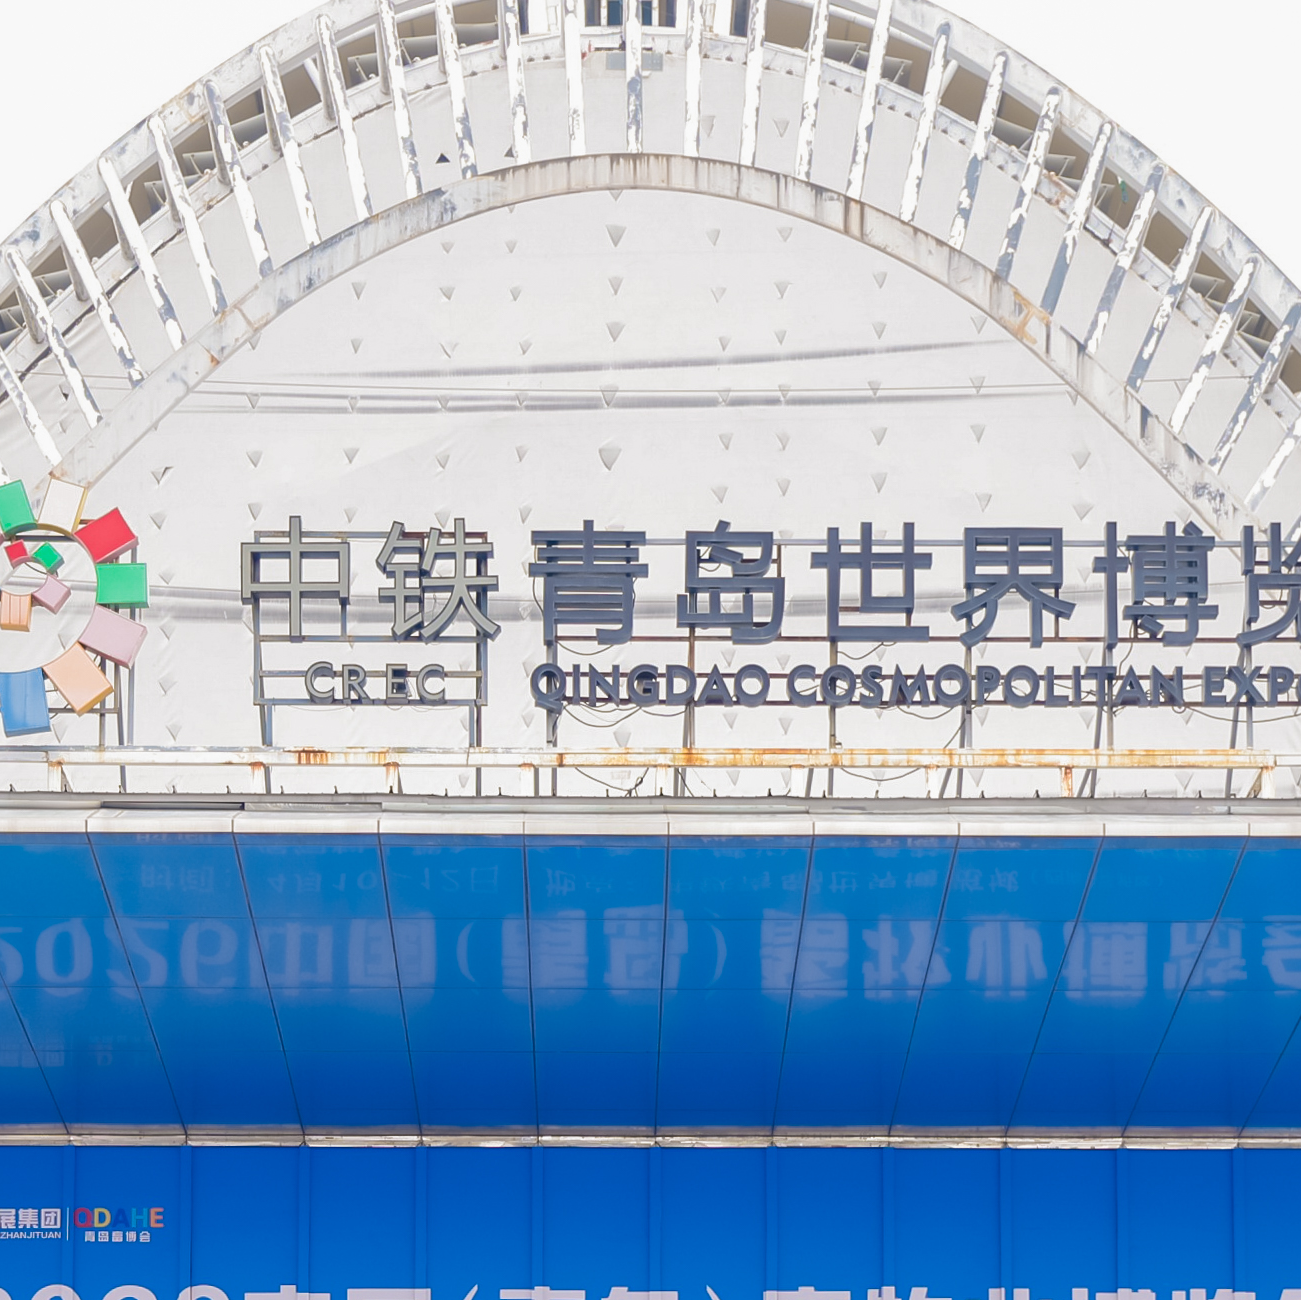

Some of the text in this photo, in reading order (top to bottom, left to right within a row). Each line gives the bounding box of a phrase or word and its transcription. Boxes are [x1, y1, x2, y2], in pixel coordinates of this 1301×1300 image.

[304, 661, 446, 703] CREC
[531, 663, 771, 714] QINGDAO
[786, 664, 1184, 709] COSMOPOLITAN
[73, 1207, 164, 1229] QDAHE
